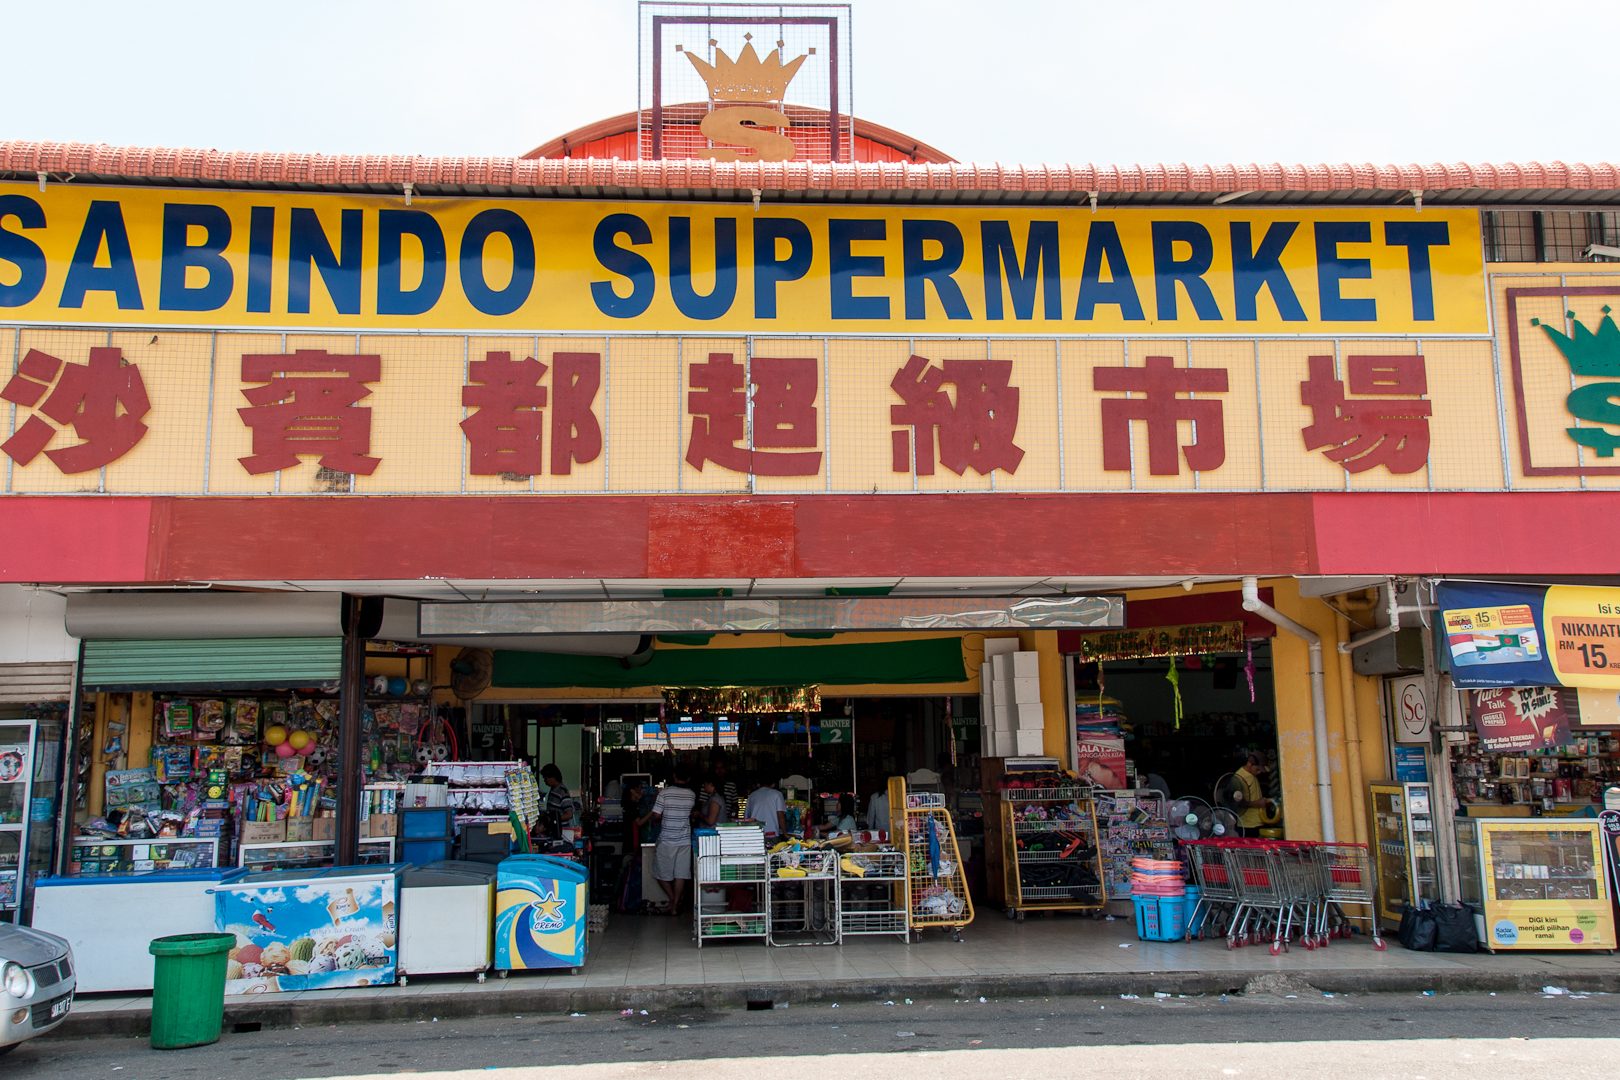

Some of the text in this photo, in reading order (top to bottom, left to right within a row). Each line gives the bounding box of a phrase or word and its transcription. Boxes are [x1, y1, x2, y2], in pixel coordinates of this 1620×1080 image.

[0, 194, 1450, 322] SABINDO SUPERMARKET
[0, 346, 1433, 477] 沙賓都超級市場
[1598, 604, 1612, 614] Isi
[1475, 611, 1490, 623] 15
[1559, 640, 1574, 650] RM
[1577, 643, 1607, 669] 15
[1487, 700, 1506, 709] Talk
[1521, 701, 1530, 714] DI
[820, 719, 851, 728] KAUNTER
[953, 717, 978, 725] AUNTER
[613, 731, 626, 745] 3
[830, 728, 843, 743] 2
[960, 726, 968, 740] 1
[481, 733, 495, 748] 5
[534, 921, 562, 930] CREMO
